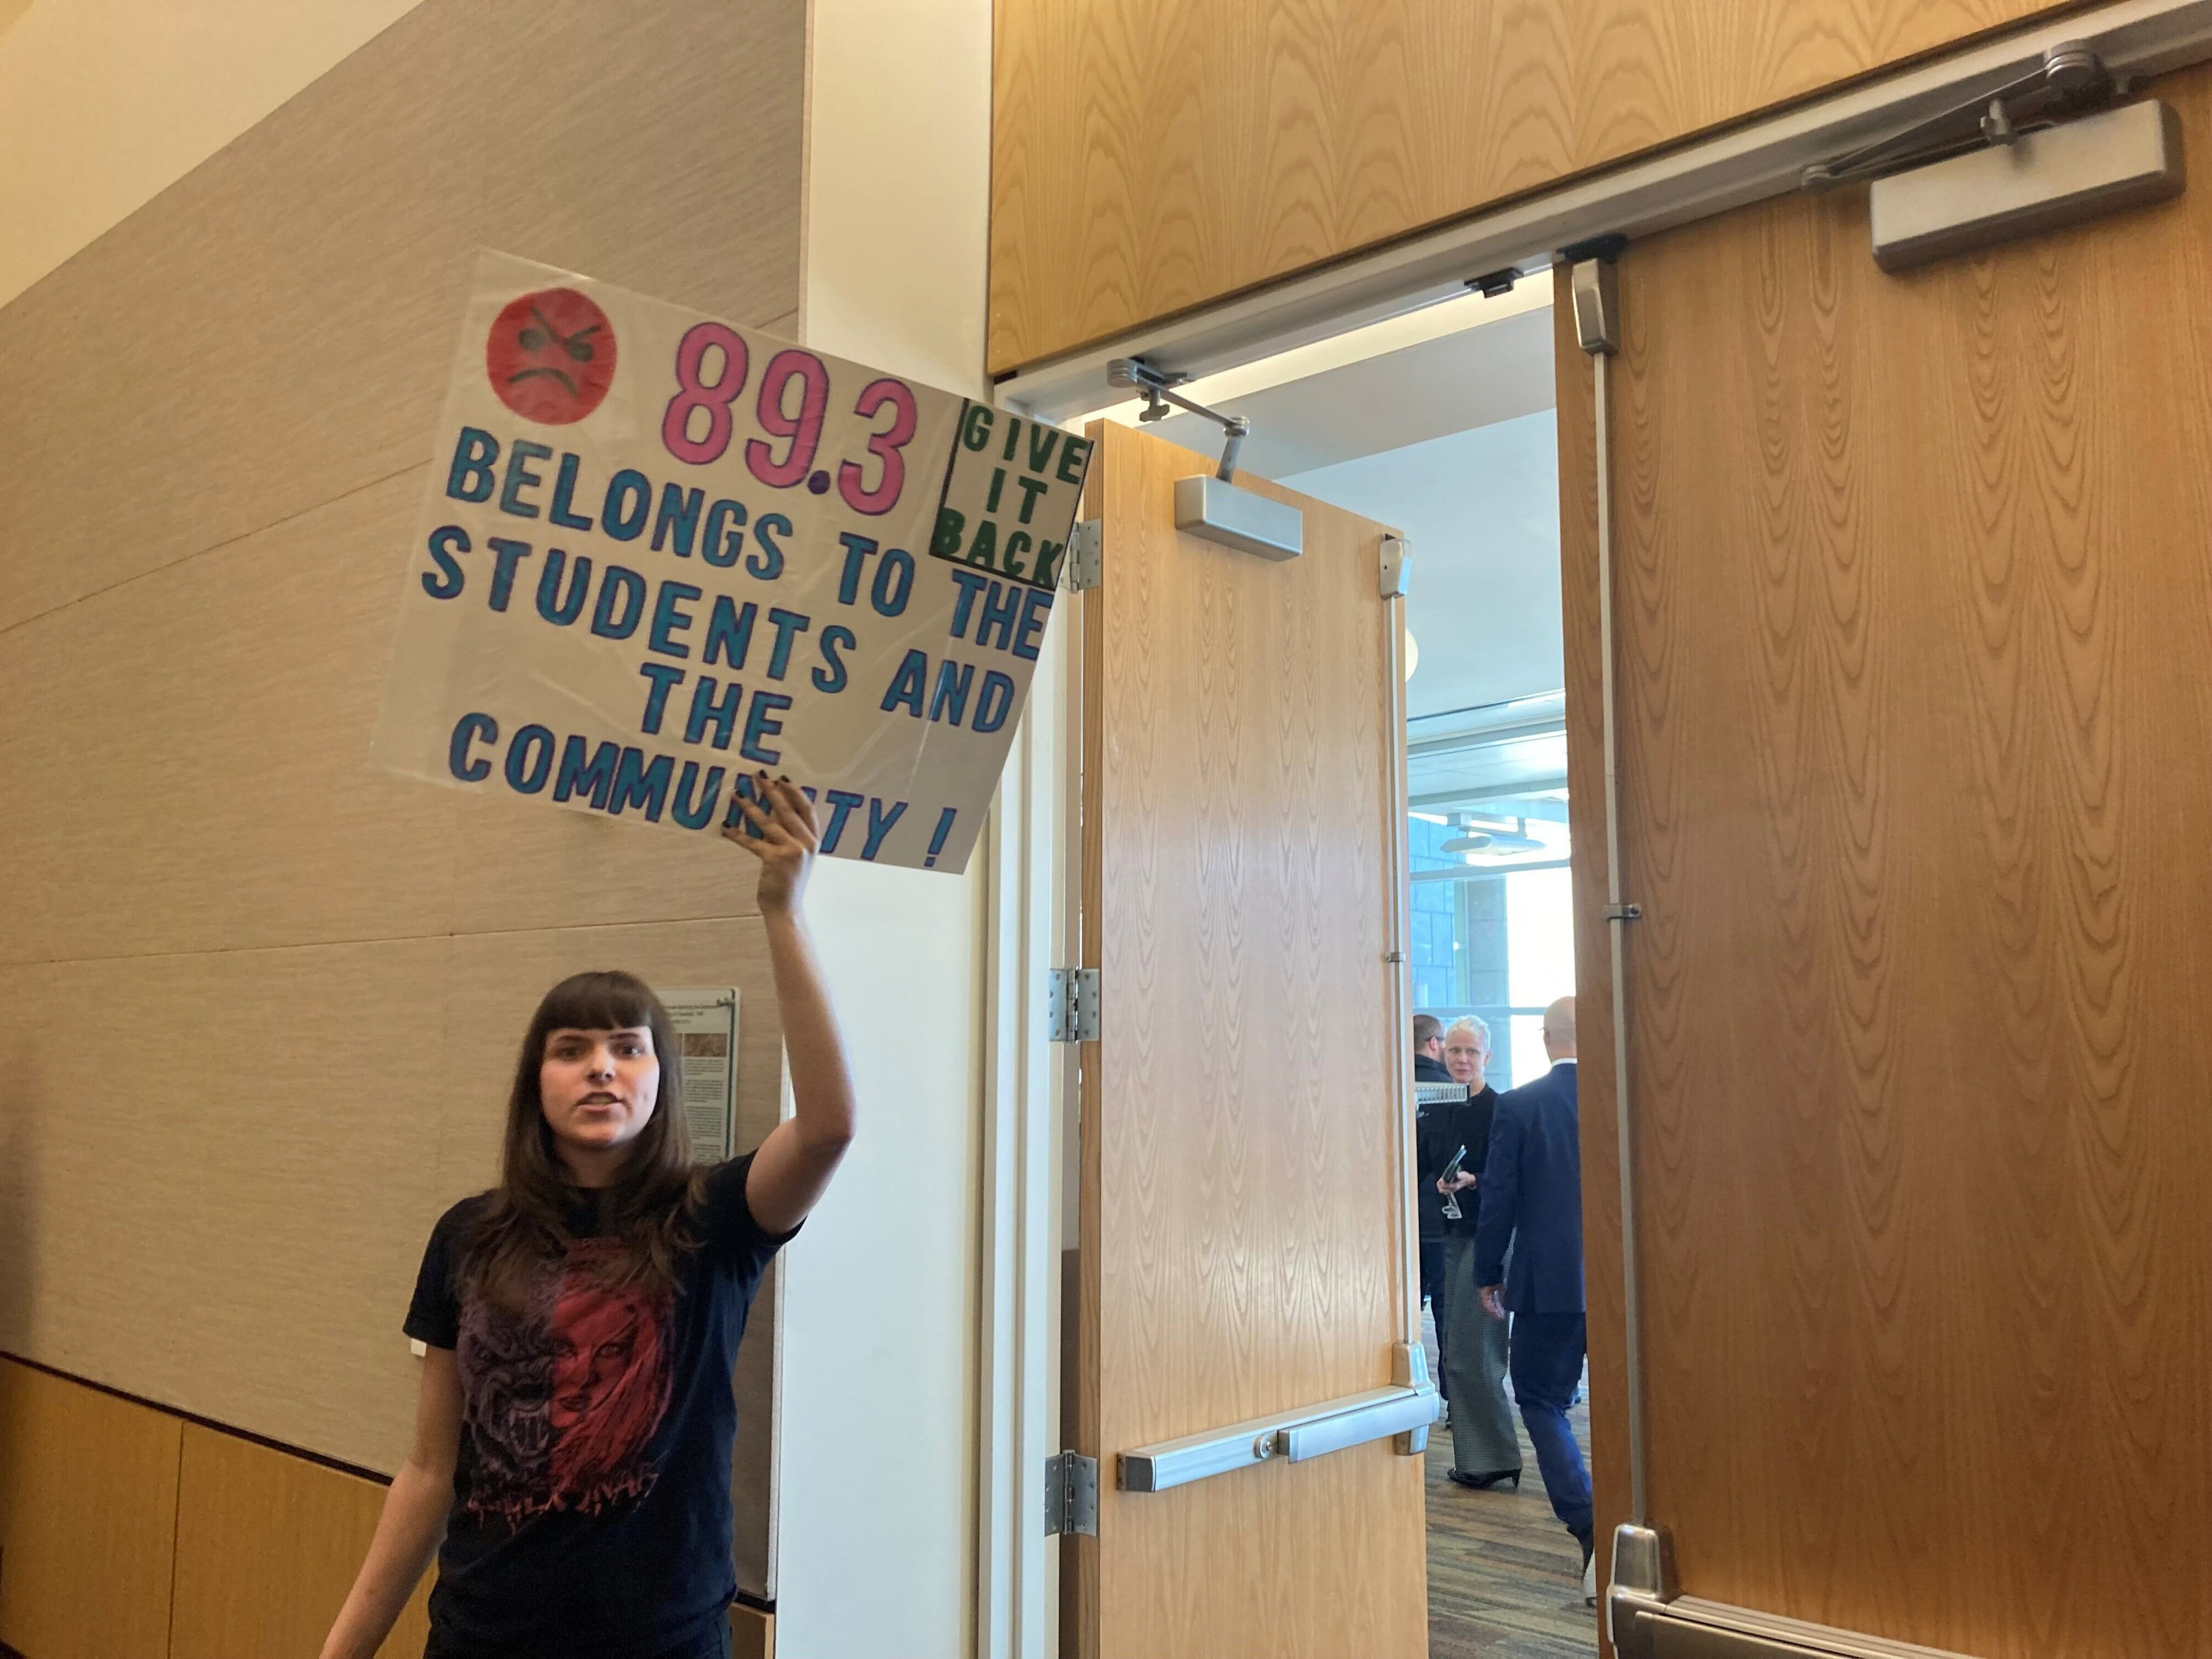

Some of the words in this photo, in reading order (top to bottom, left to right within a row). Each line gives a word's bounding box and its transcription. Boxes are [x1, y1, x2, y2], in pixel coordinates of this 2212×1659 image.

[662, 322, 918, 516] 89.3
[963, 405, 1090, 485] GIVE
[446, 426, 793, 581] BELONGS
[836, 532, 916, 617] TO
[950, 568, 1055, 660] THE
[933, 507, 1064, 588] BACK
[986, 467, 1048, 524] IT
[421, 525, 857, 694] STUDENTS
[880, 650, 1016, 732] AND
[640, 662, 793, 765] THE
[449, 712, 909, 861] COMMUNTY
[924, 807, 957, 868] !
